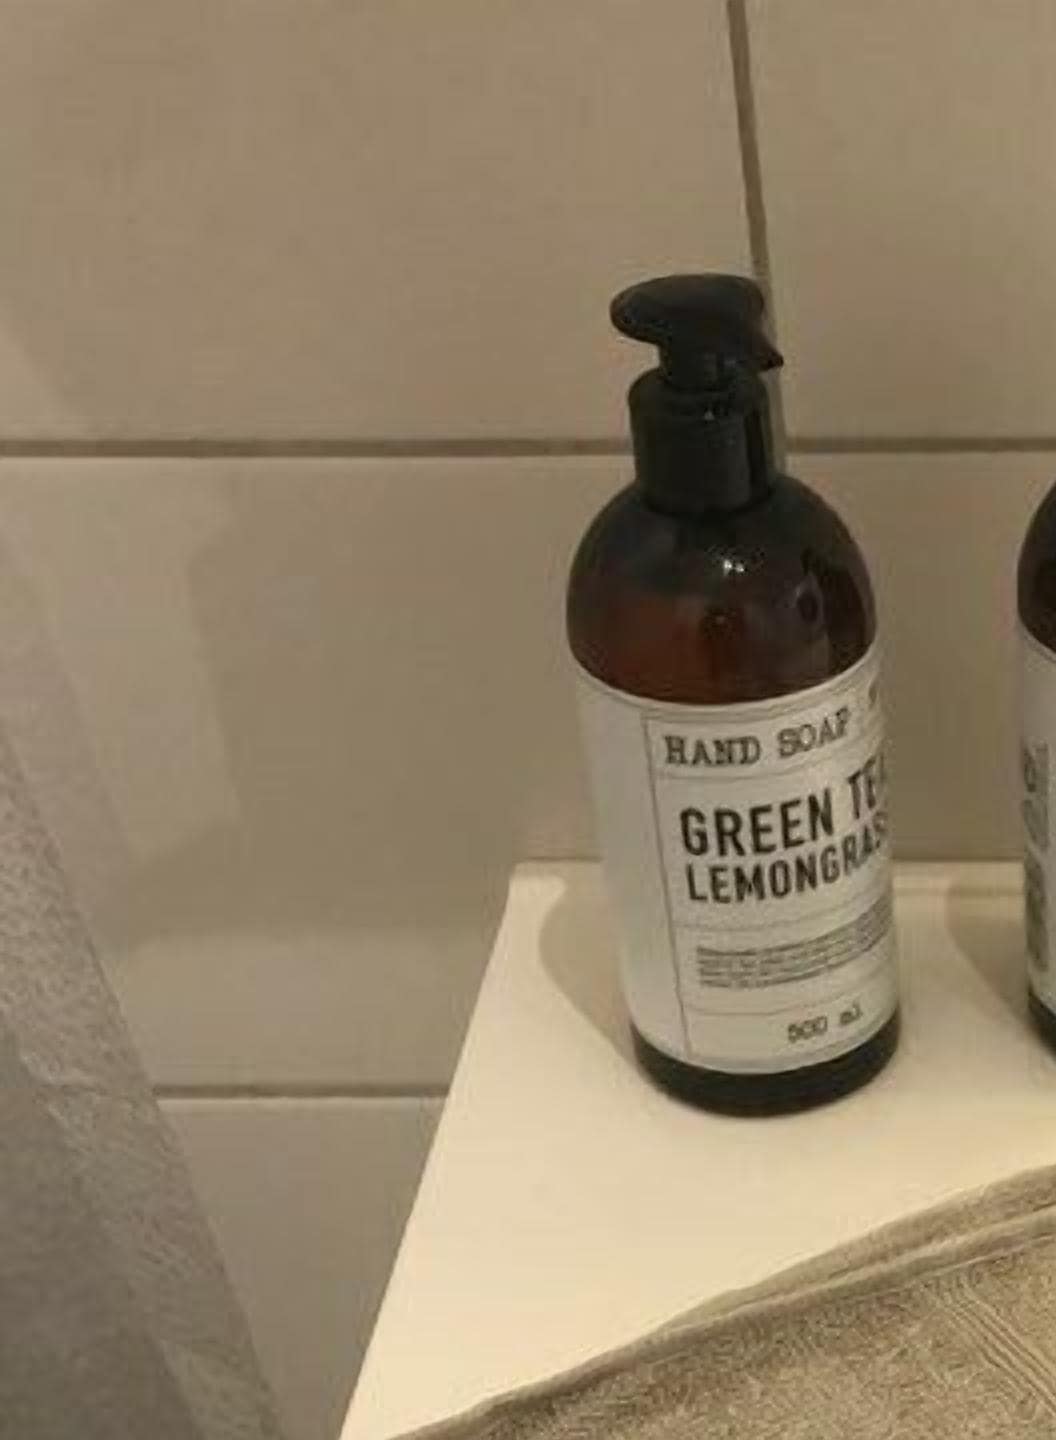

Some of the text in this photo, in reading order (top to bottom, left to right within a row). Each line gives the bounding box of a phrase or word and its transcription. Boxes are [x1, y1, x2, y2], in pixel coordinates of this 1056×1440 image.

[664, 706, 850, 769] HAND SOAP
[678, 786, 834, 858] GREEN
